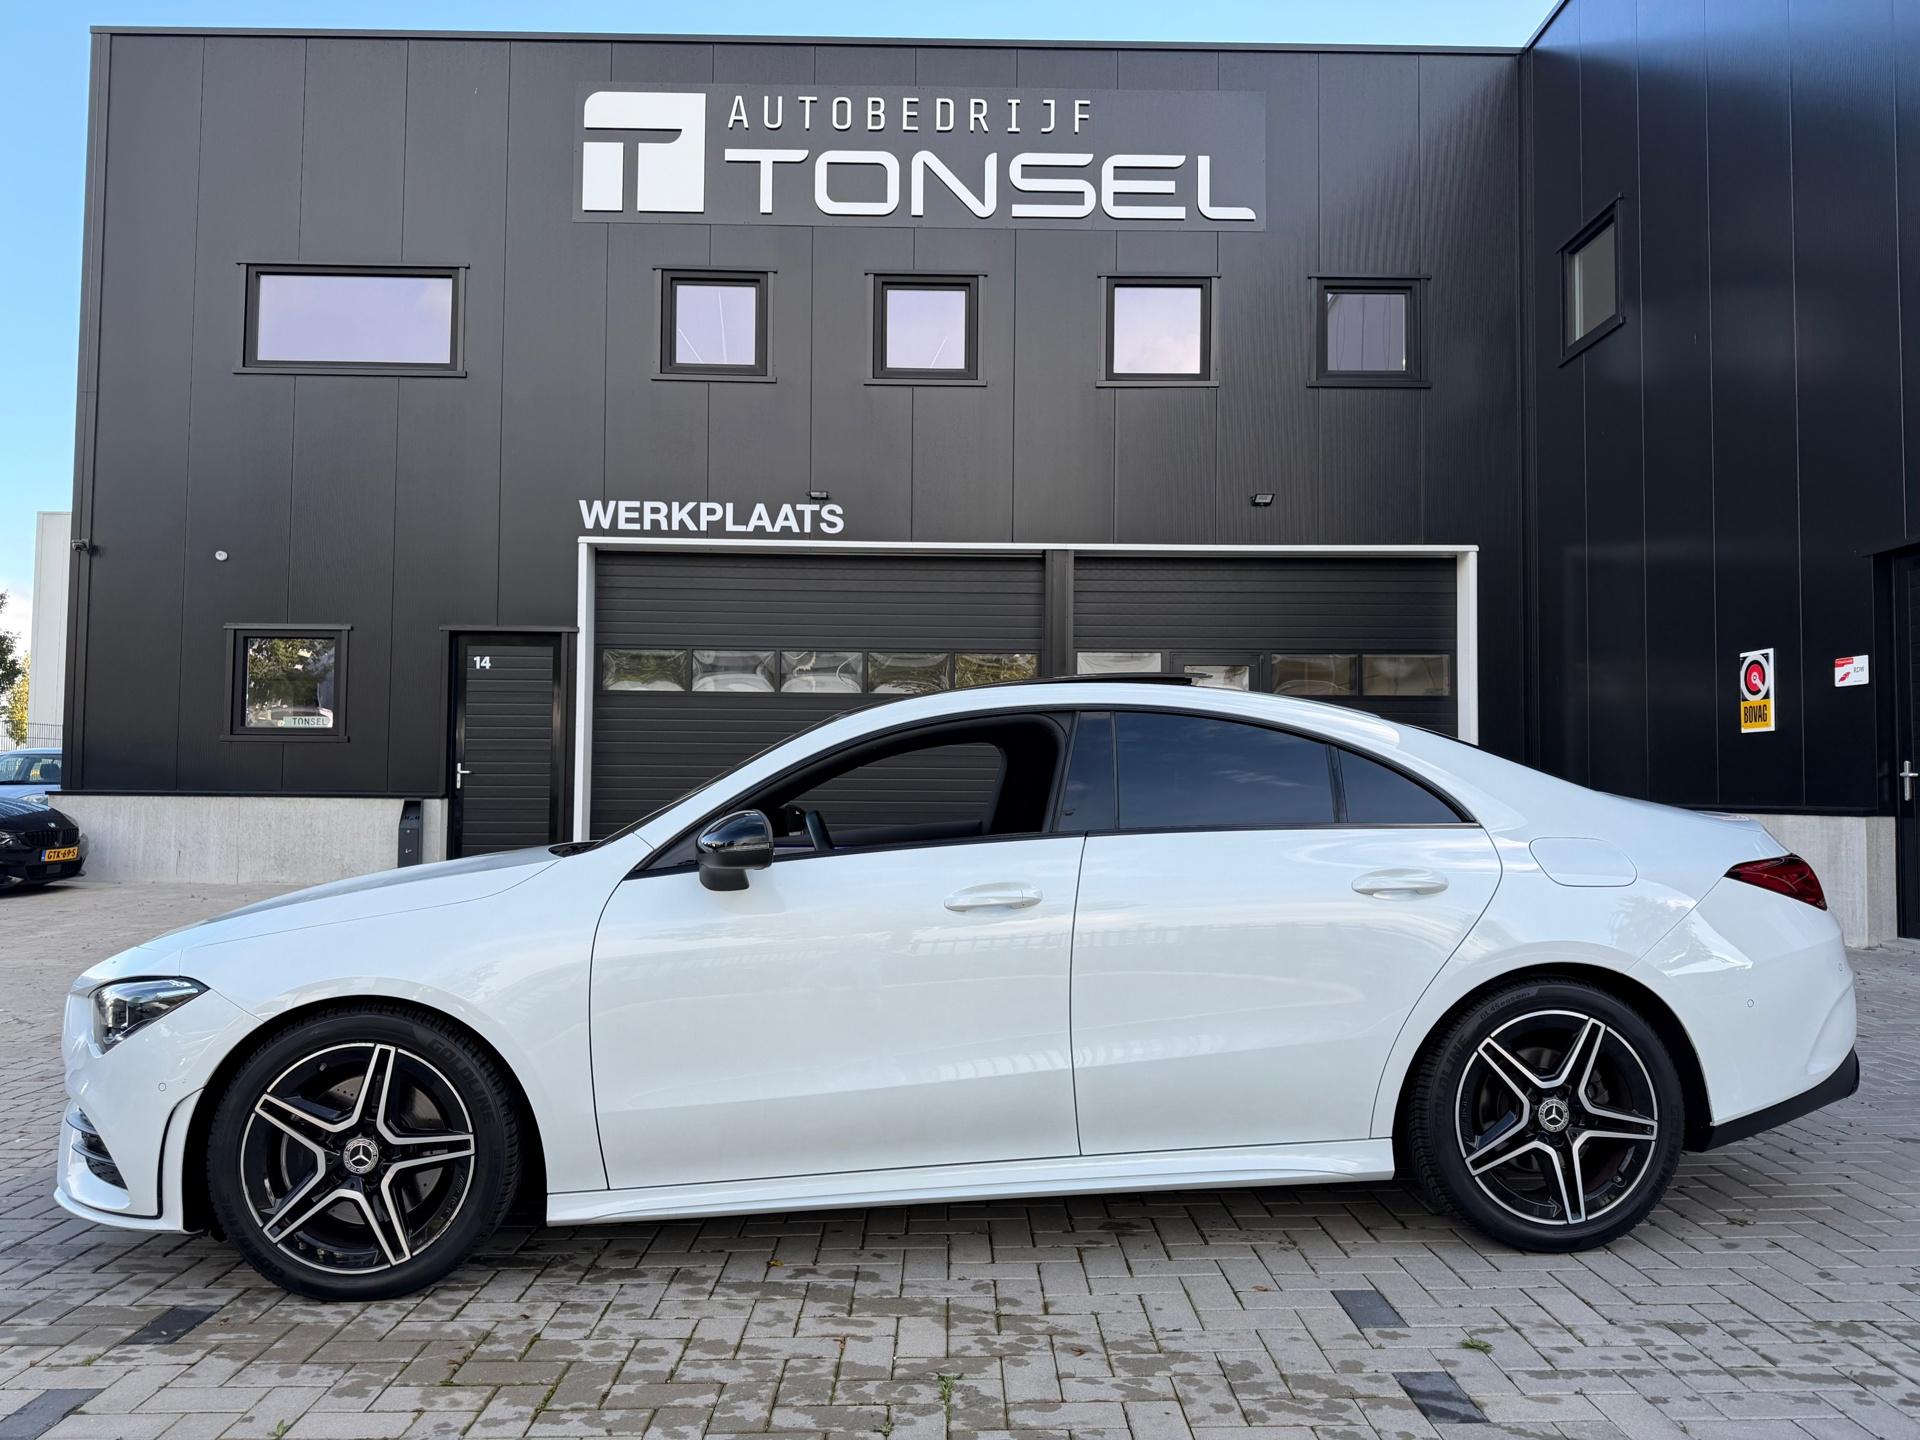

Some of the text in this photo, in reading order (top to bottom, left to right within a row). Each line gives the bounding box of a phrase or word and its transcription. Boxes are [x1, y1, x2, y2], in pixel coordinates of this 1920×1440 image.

[728, 96, 1090, 133] AUTOBEDRIJF
[725, 149, 1256, 220] TONSEL
[579, 500, 844, 534] WERKPLAATS
[474, 656, 491, 669] 14
[292, 717, 326, 726] TONSEL
[1744, 705, 1767, 723] BOVAG
